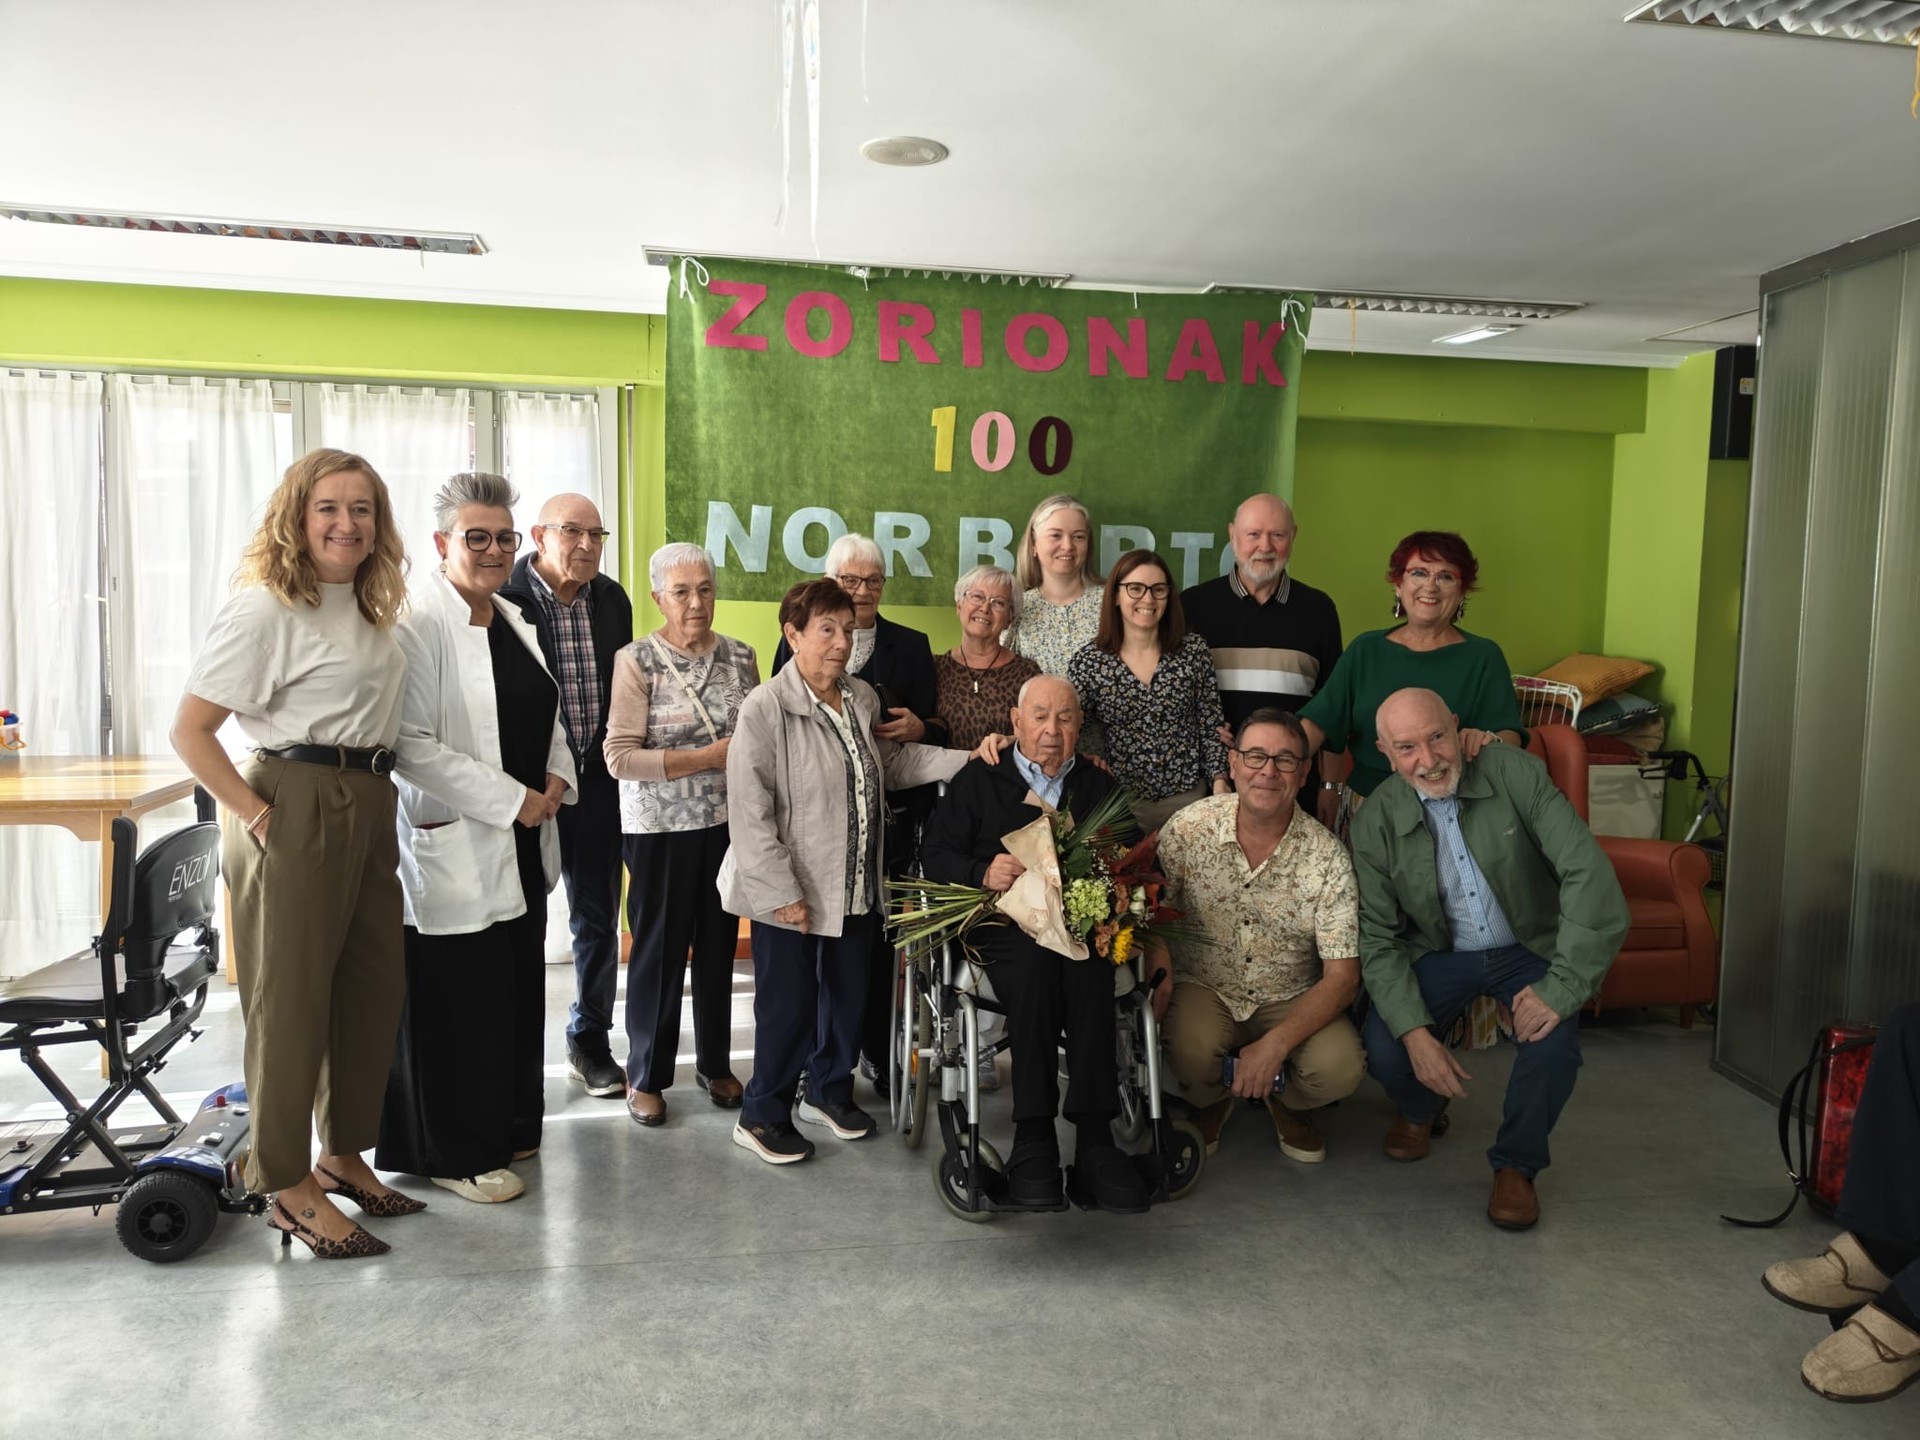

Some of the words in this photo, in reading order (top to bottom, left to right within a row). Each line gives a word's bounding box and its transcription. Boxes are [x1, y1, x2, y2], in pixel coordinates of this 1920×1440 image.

[705, 280, 1288, 386] ZORIONAK
[931, 406, 1073, 476] 100
[705, 501, 1238, 591] NORBRT
